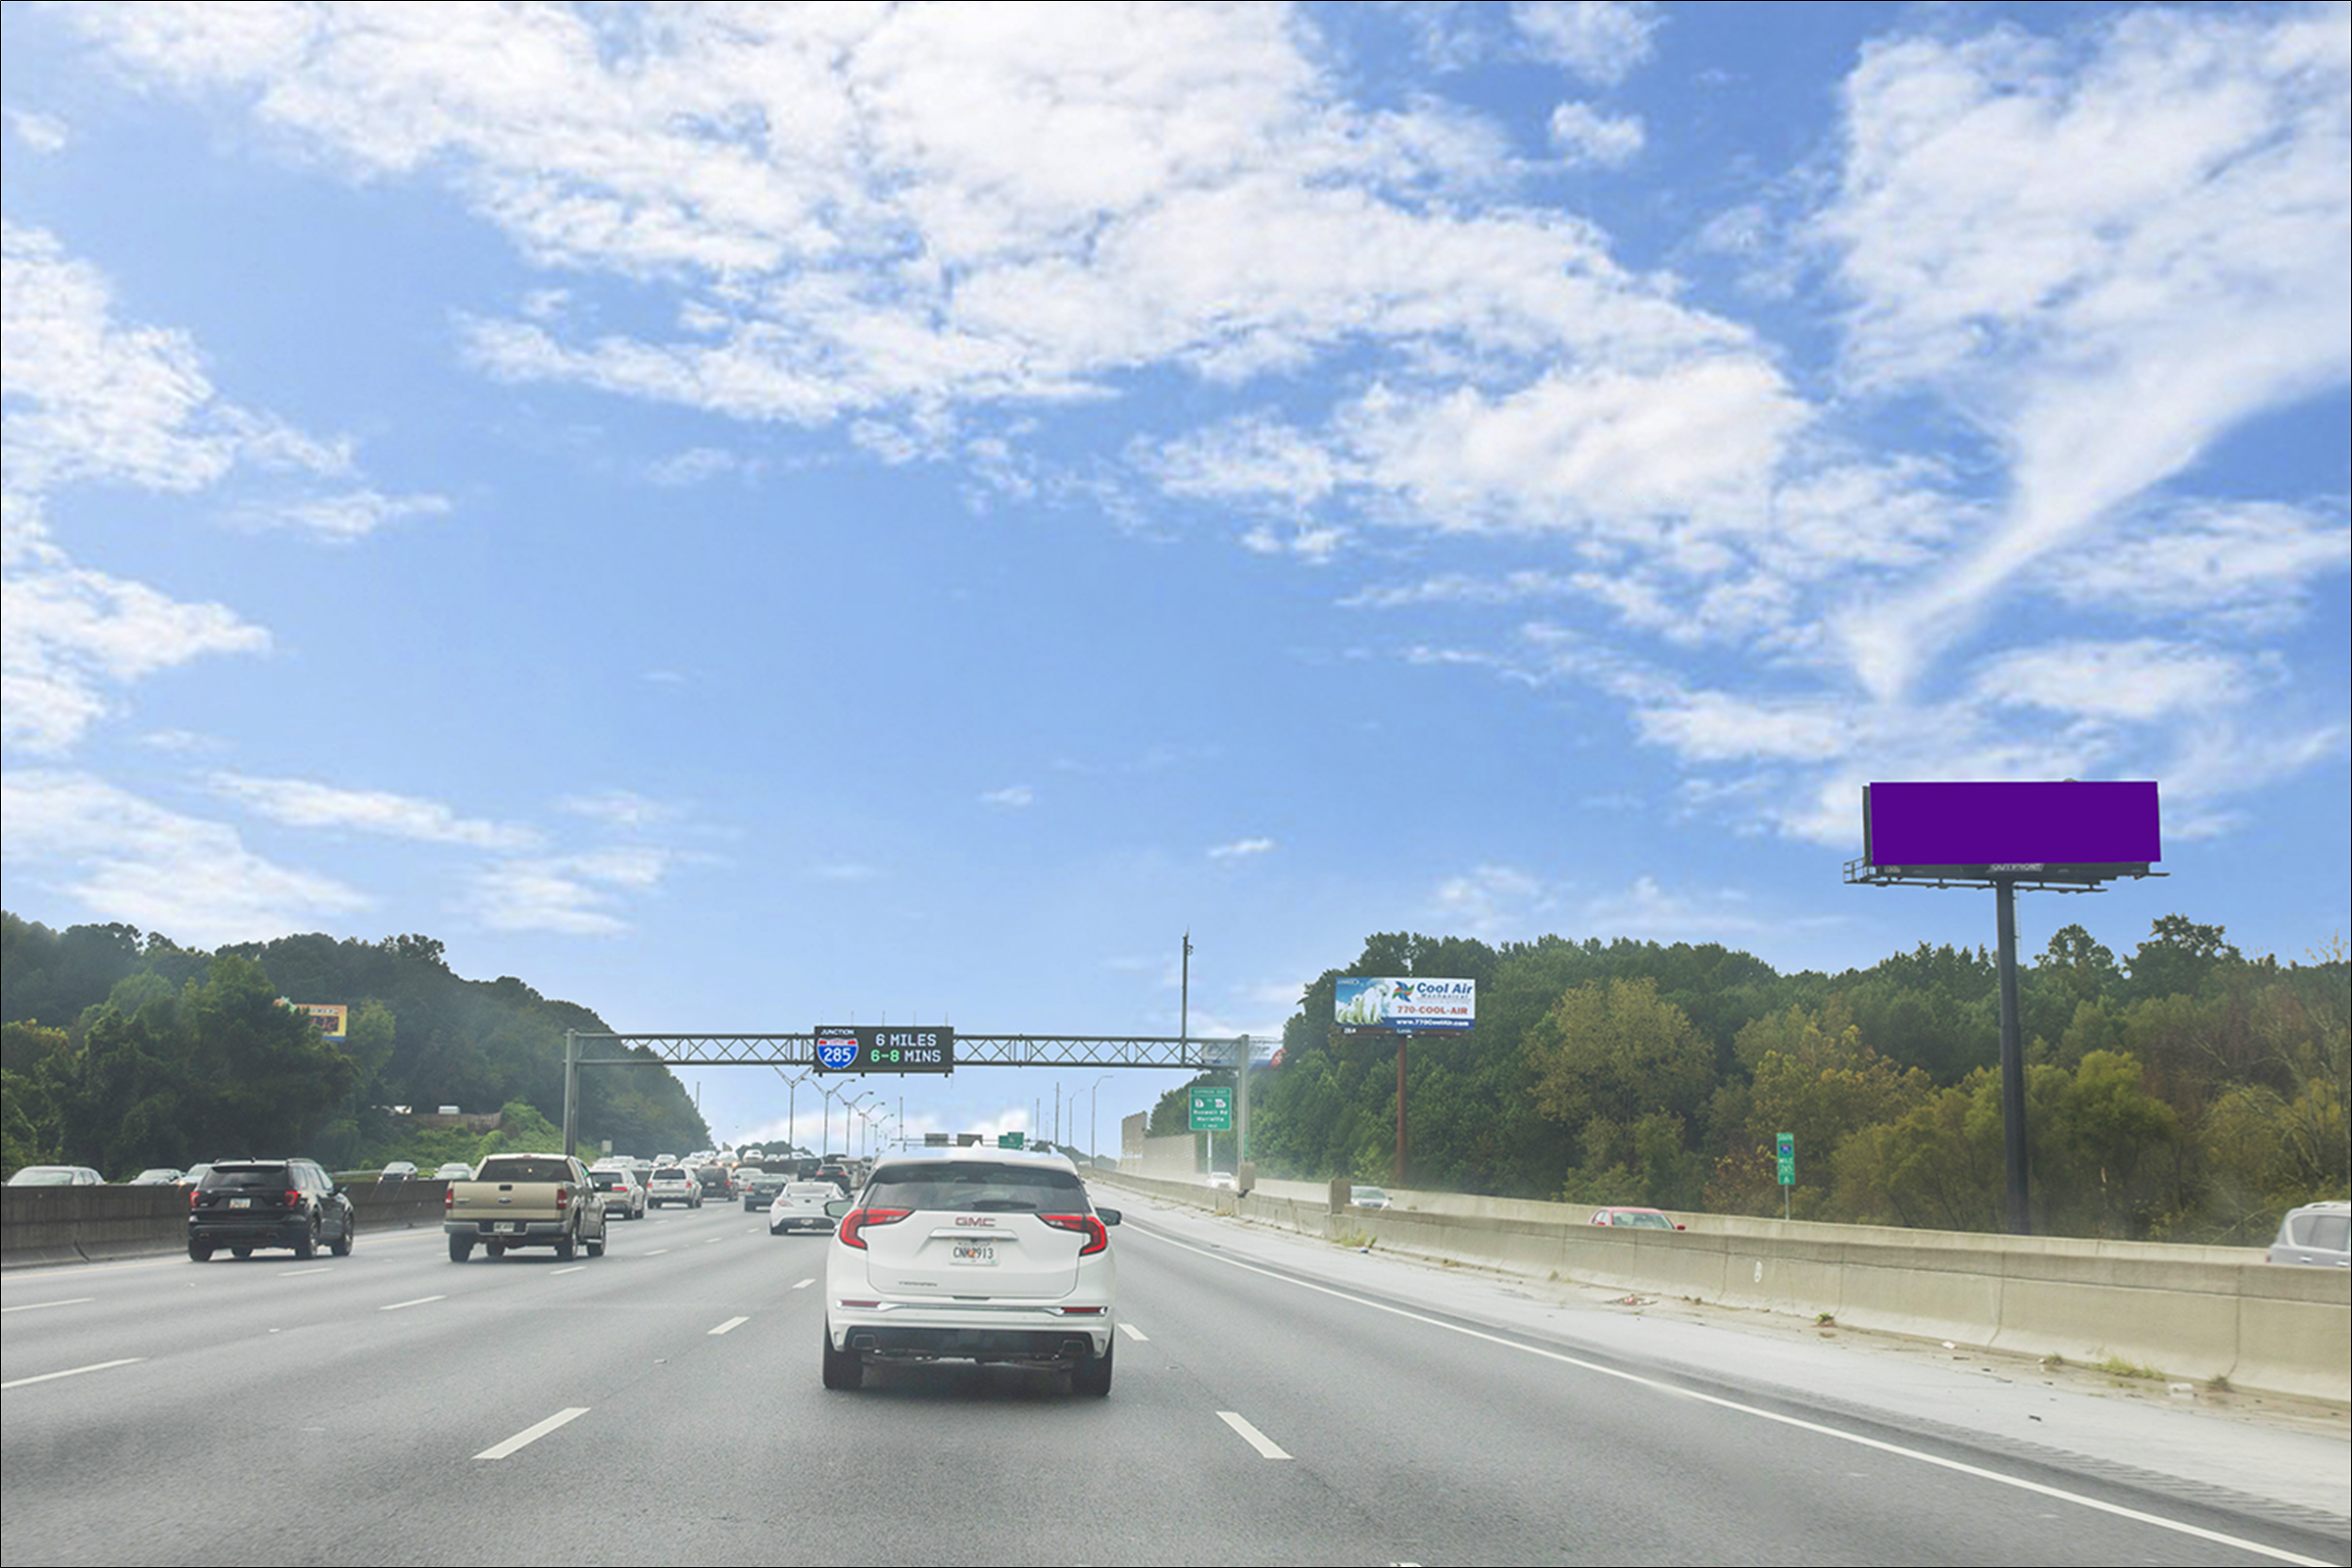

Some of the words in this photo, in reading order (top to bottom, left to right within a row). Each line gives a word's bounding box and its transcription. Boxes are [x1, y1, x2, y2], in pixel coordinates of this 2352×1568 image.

[1416, 982, 1449, 994] Cool
[1451, 983, 1473, 994] Air
[1396, 1005, 1468, 1015] 770-COOL-AIR
[875, 1034, 886, 1047] 6
[889, 1033, 937, 1047] MILES
[823, 1047, 852, 1063] 285
[870, 1049, 901, 1063] 6-8
[904, 1050, 942, 1063] MINS
[955, 1216, 996, 1227] GMC
